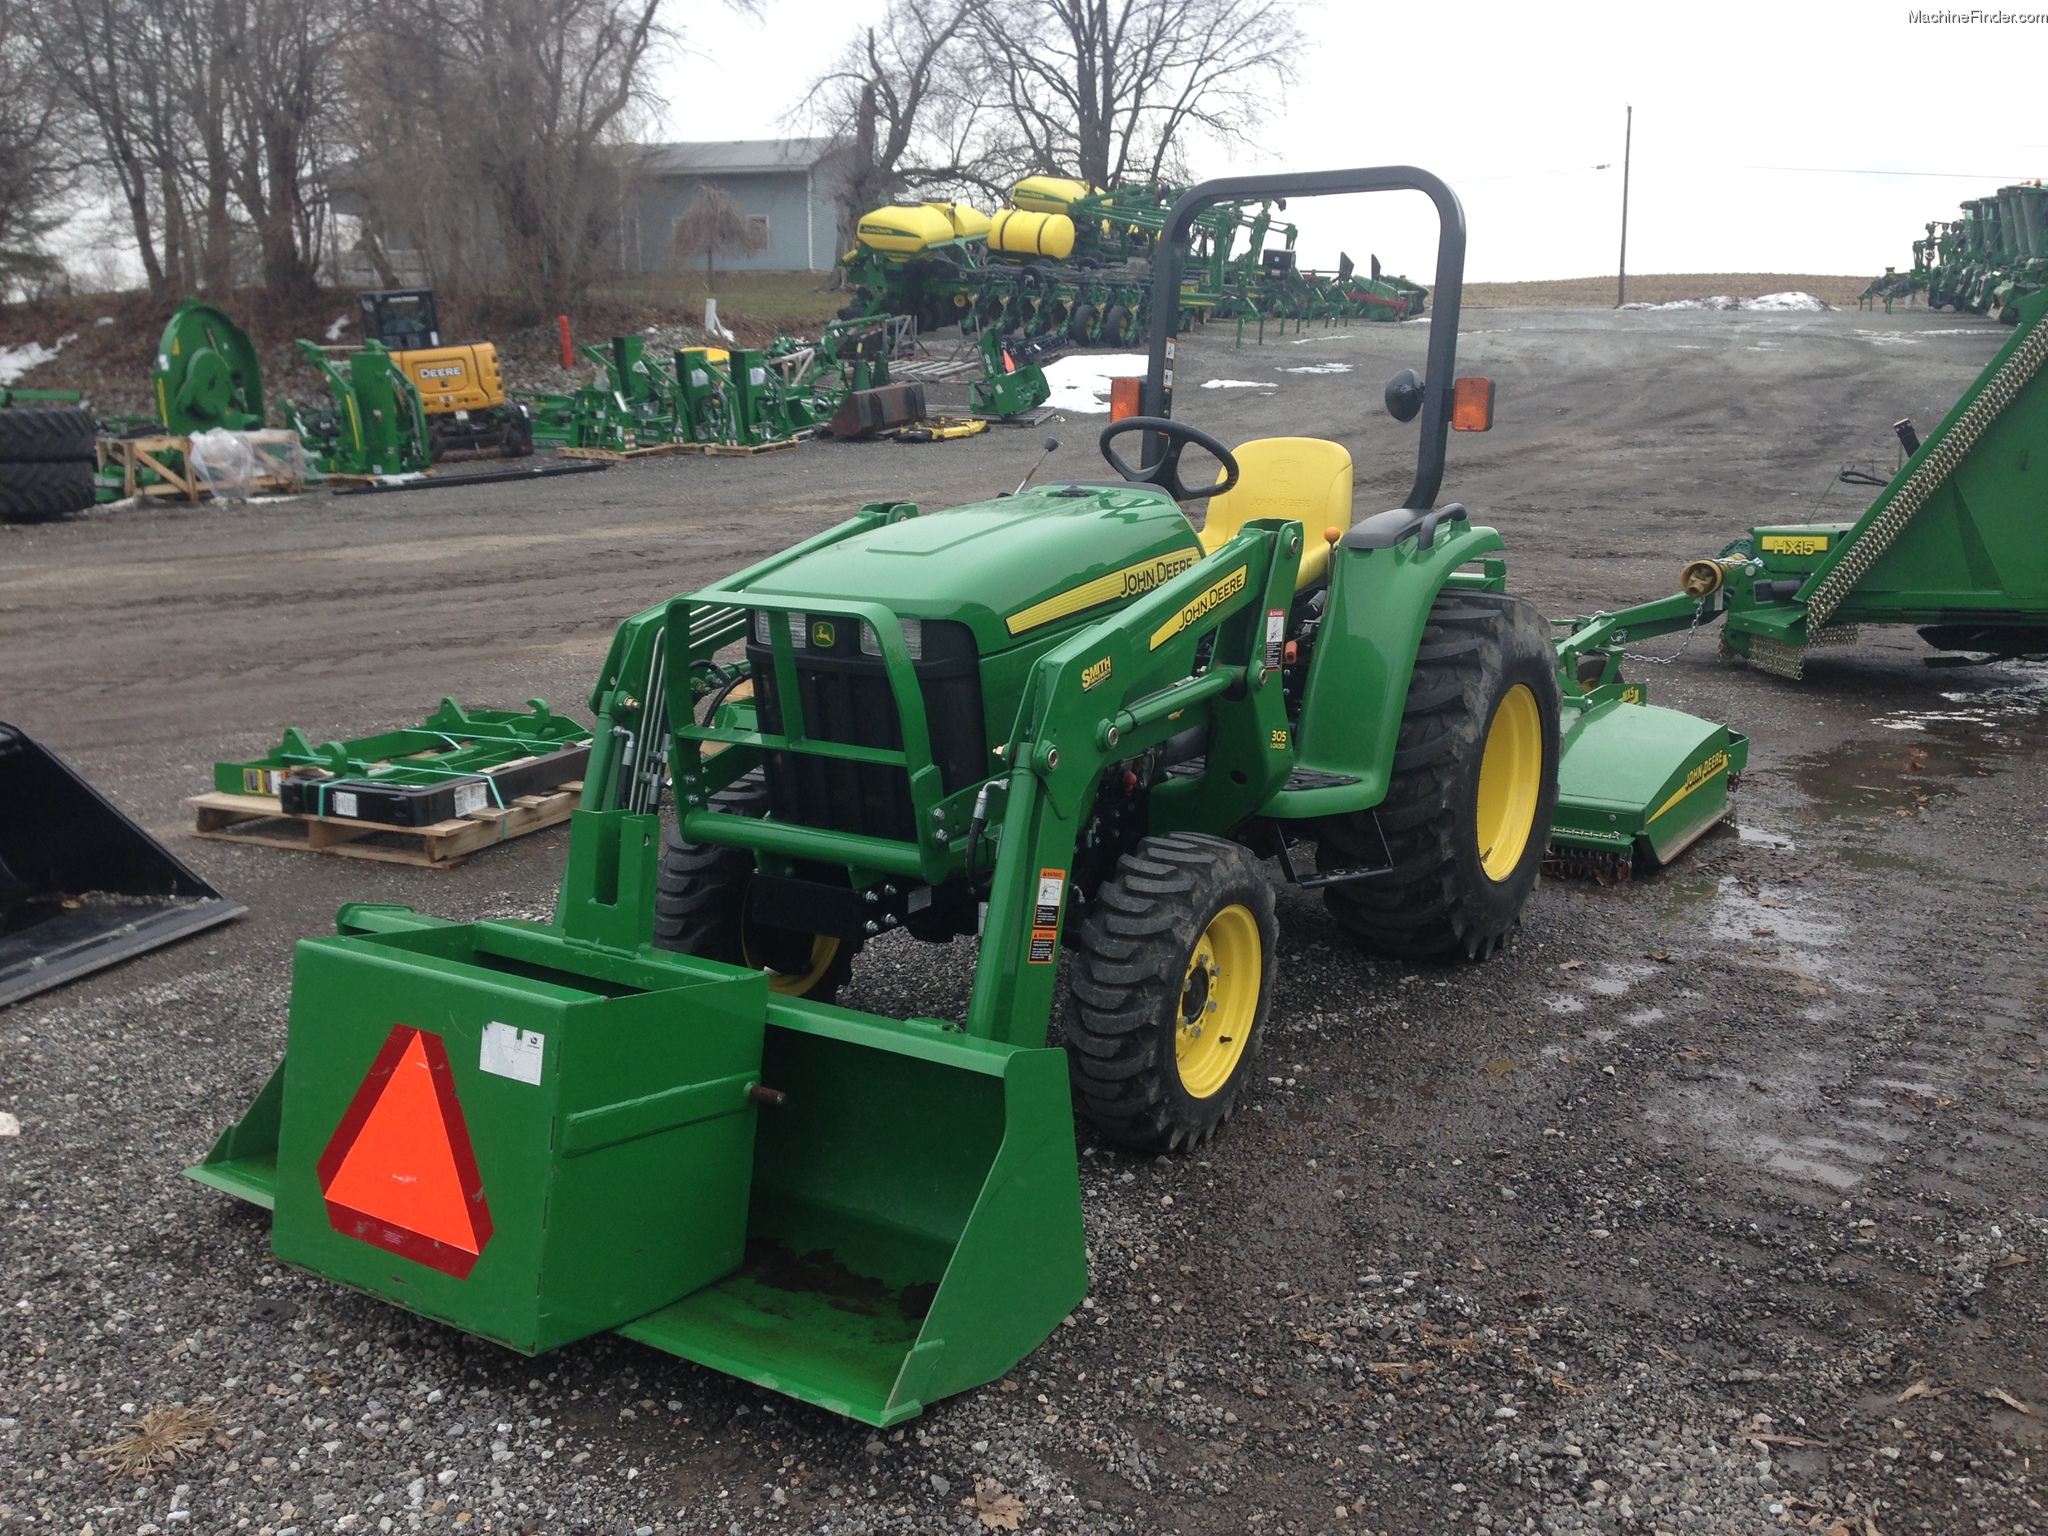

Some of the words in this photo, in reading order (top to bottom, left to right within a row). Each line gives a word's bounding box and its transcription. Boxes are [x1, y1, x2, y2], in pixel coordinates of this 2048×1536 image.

[420, 366, 461, 379] DEERE
[1773, 540, 1815, 556] HX15
[1120, 567, 1156, 596] JOHN
[1156, 557, 1193, 583] DEERE
[1179, 596, 1208, 630] JOHN
[1208, 573, 1243, 607] DEERE
[1081, 655, 1111, 688] SMITH
[1271, 729, 1287, 742] 305
[1685, 763, 1703, 789] JOHN
[1703, 750, 1723, 776] DEERE
